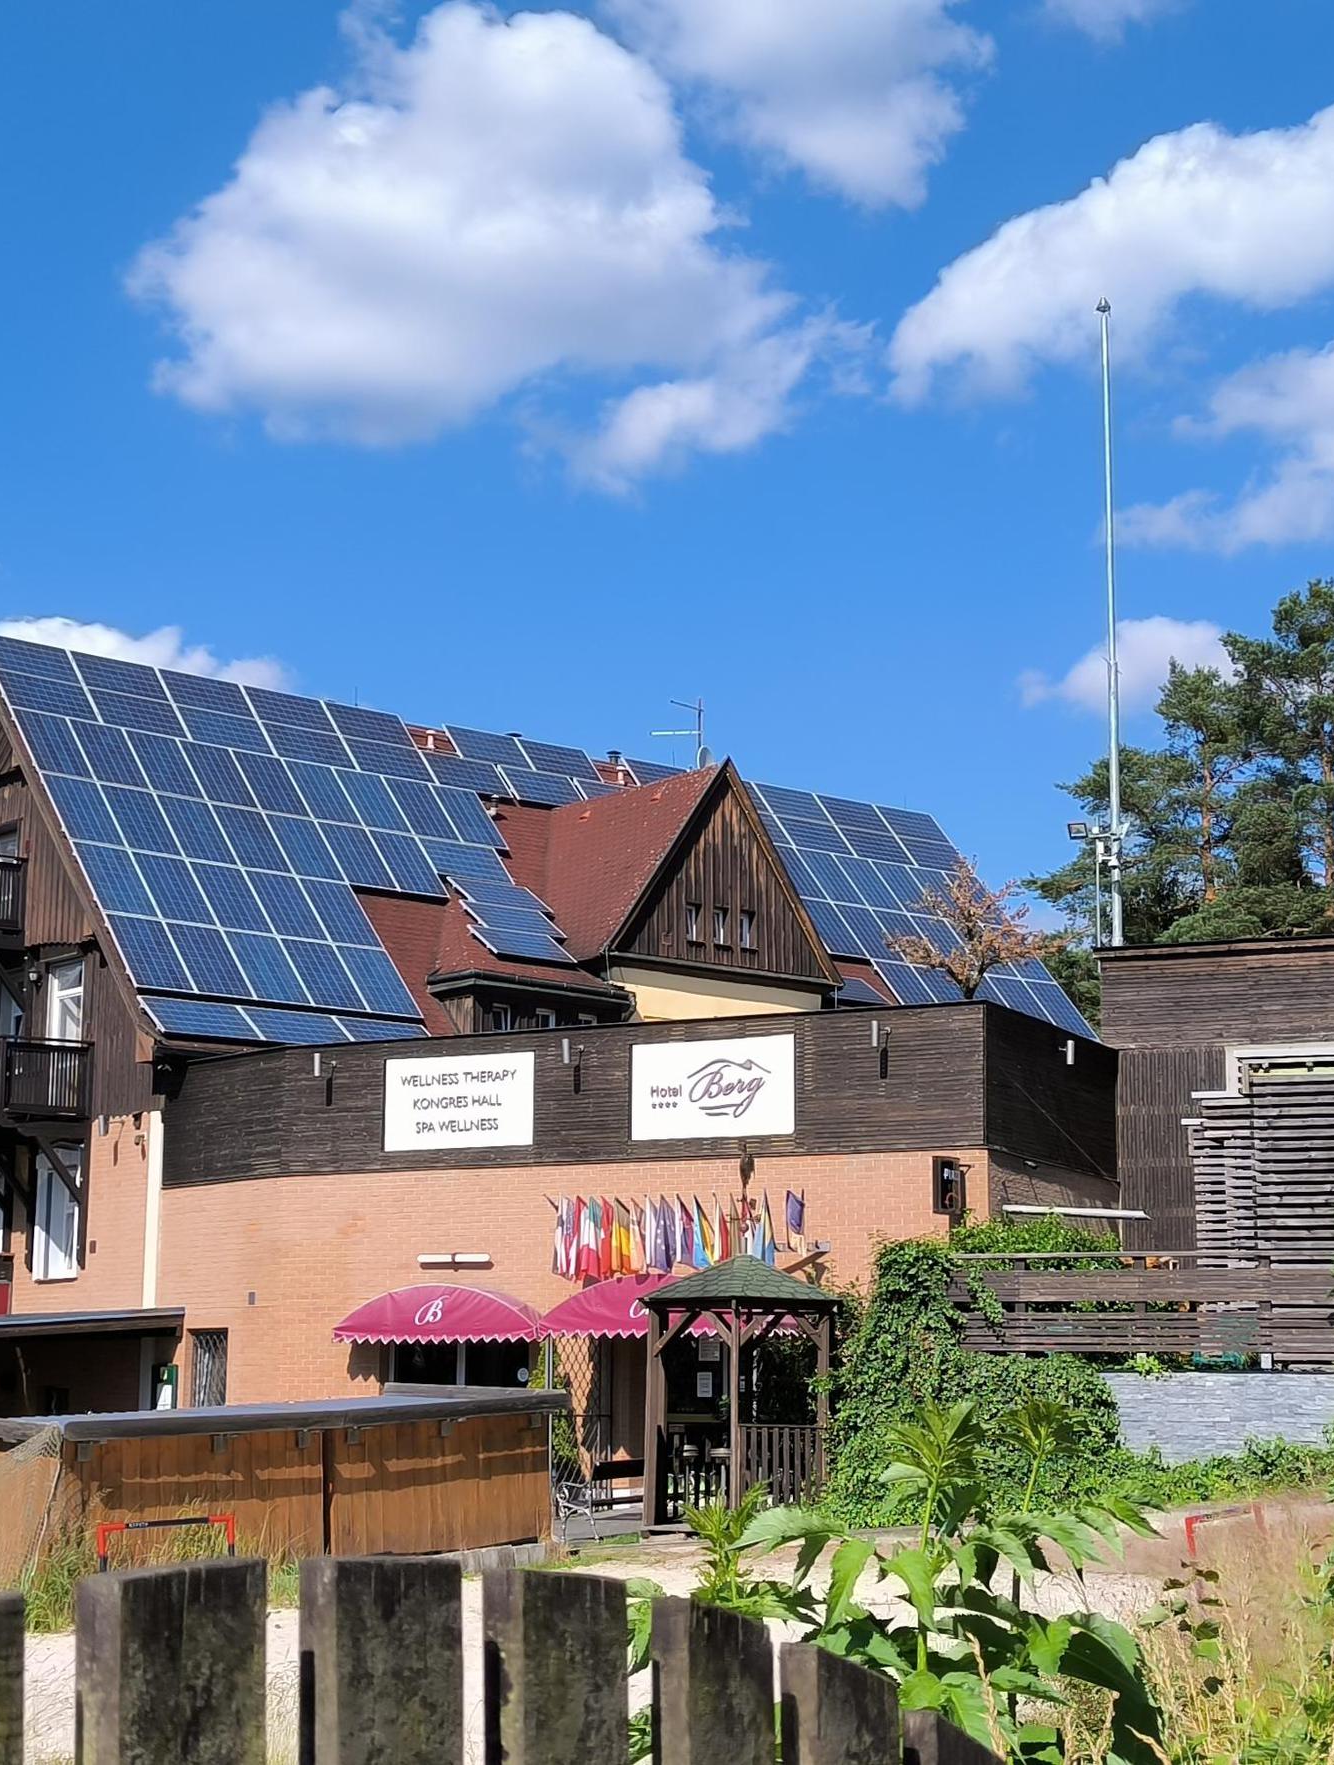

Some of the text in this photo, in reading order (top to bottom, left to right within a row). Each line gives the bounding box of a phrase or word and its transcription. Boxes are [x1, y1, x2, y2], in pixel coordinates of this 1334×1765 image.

[400, 1069, 517, 1088] WELLNESS THERAPY
[650, 1064, 766, 1119] Hotel Berg
[413, 1093, 503, 1111] KONGRES HALL
[415, 1118, 499, 1134] SPA WELLNESS
[414, 1295, 450, 1326] B
